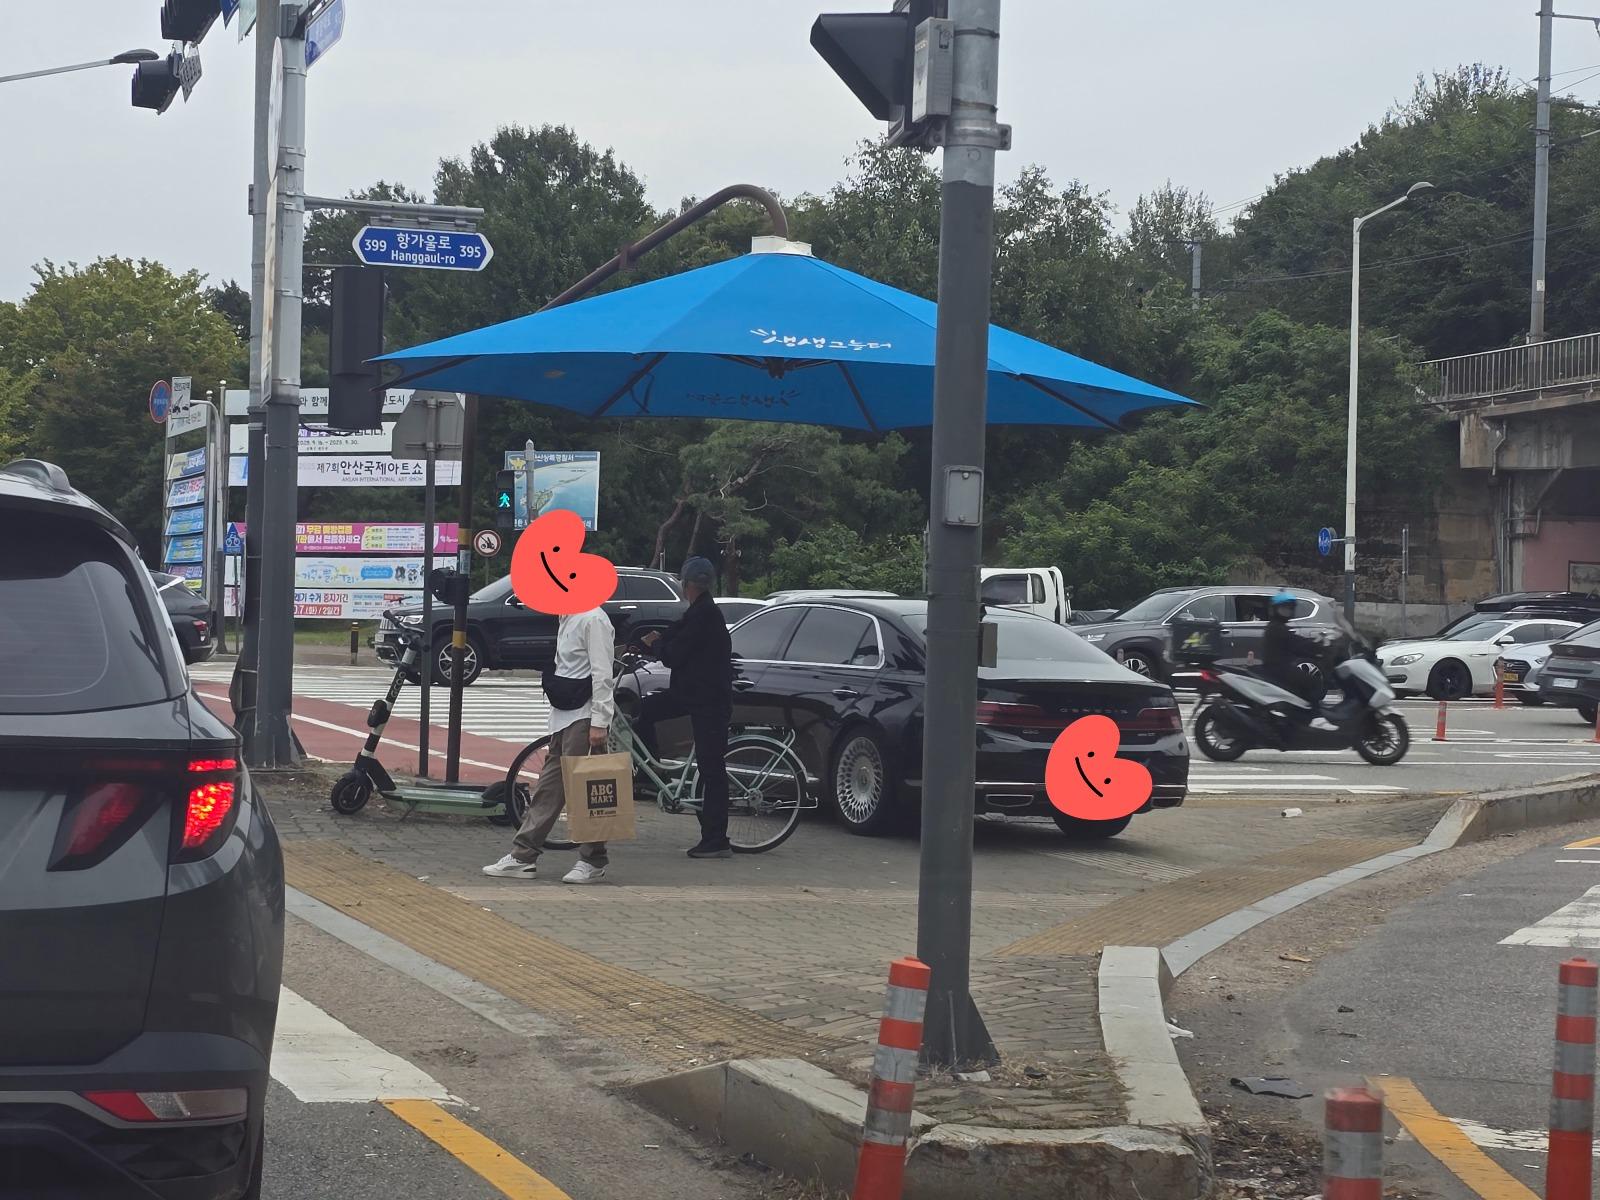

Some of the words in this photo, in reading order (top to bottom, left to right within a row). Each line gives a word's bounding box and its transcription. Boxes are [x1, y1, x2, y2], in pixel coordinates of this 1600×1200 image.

[364, 239, 387, 252] 399
[397, 233, 451, 251] 항가울로
[391, 250, 456, 265] Hanggaul-ro
[459, 245, 481, 258] 395
[317, 462, 339, 474] 제7회
[340, 461, 423, 476] 안산국제아트쇼
[309, 592, 321, 603] 수거
[591, 784, 613, 795] ABC
[591, 795, 614, 804] MART
